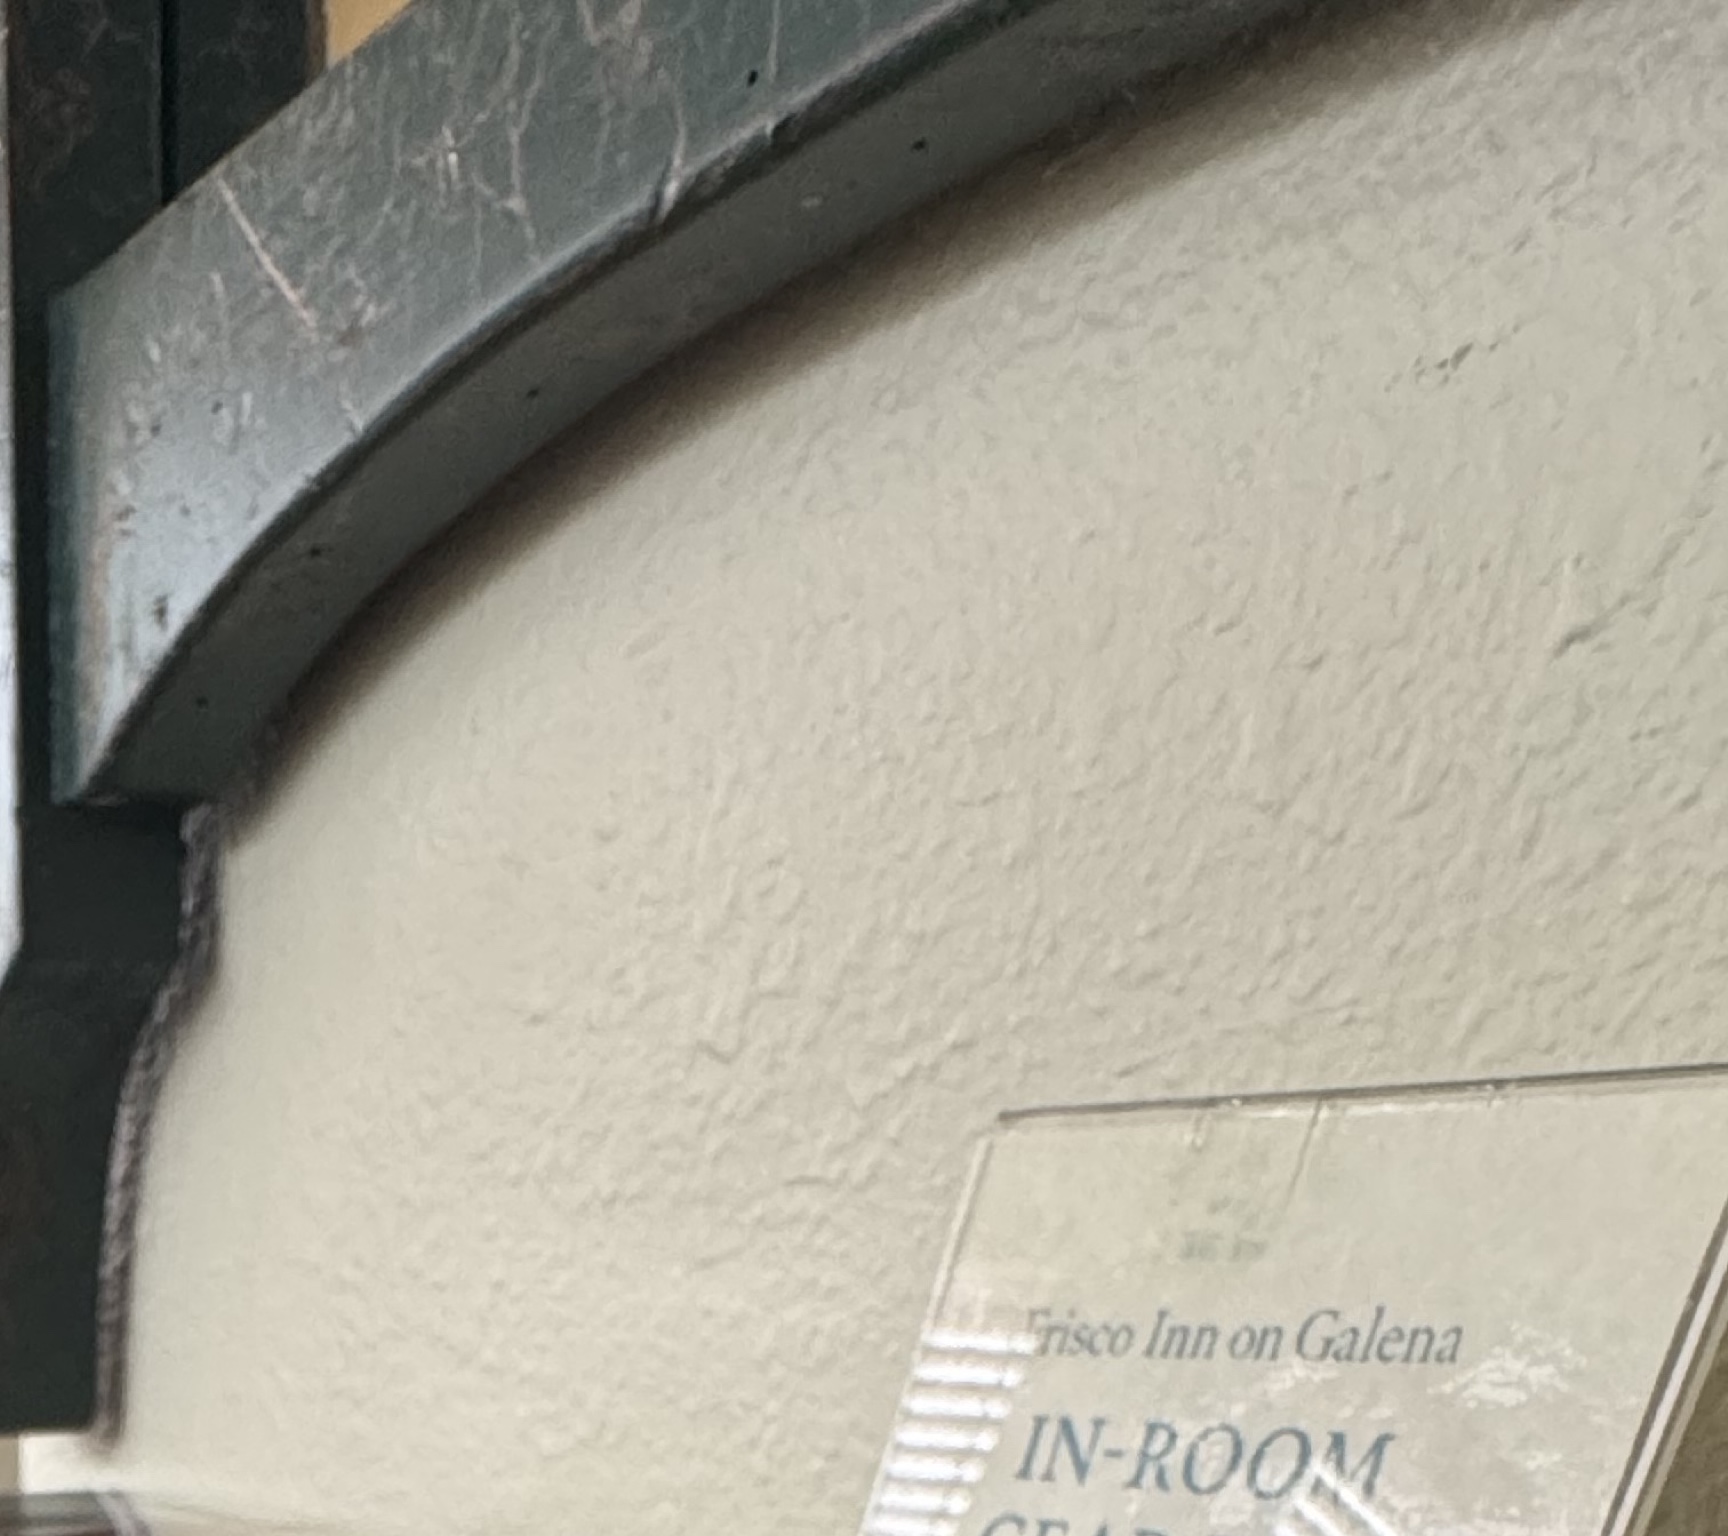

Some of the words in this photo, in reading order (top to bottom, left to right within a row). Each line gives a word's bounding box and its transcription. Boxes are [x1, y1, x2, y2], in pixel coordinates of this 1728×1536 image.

[1027, 1307, 1135, 1360] Frisco
[1142, 1309, 1218, 1361] Inn
[1228, 1322, 1284, 1363] on
[1294, 1305, 1465, 1365] Galena
[1014, 1413, 1397, 1500] IN-ROOM
